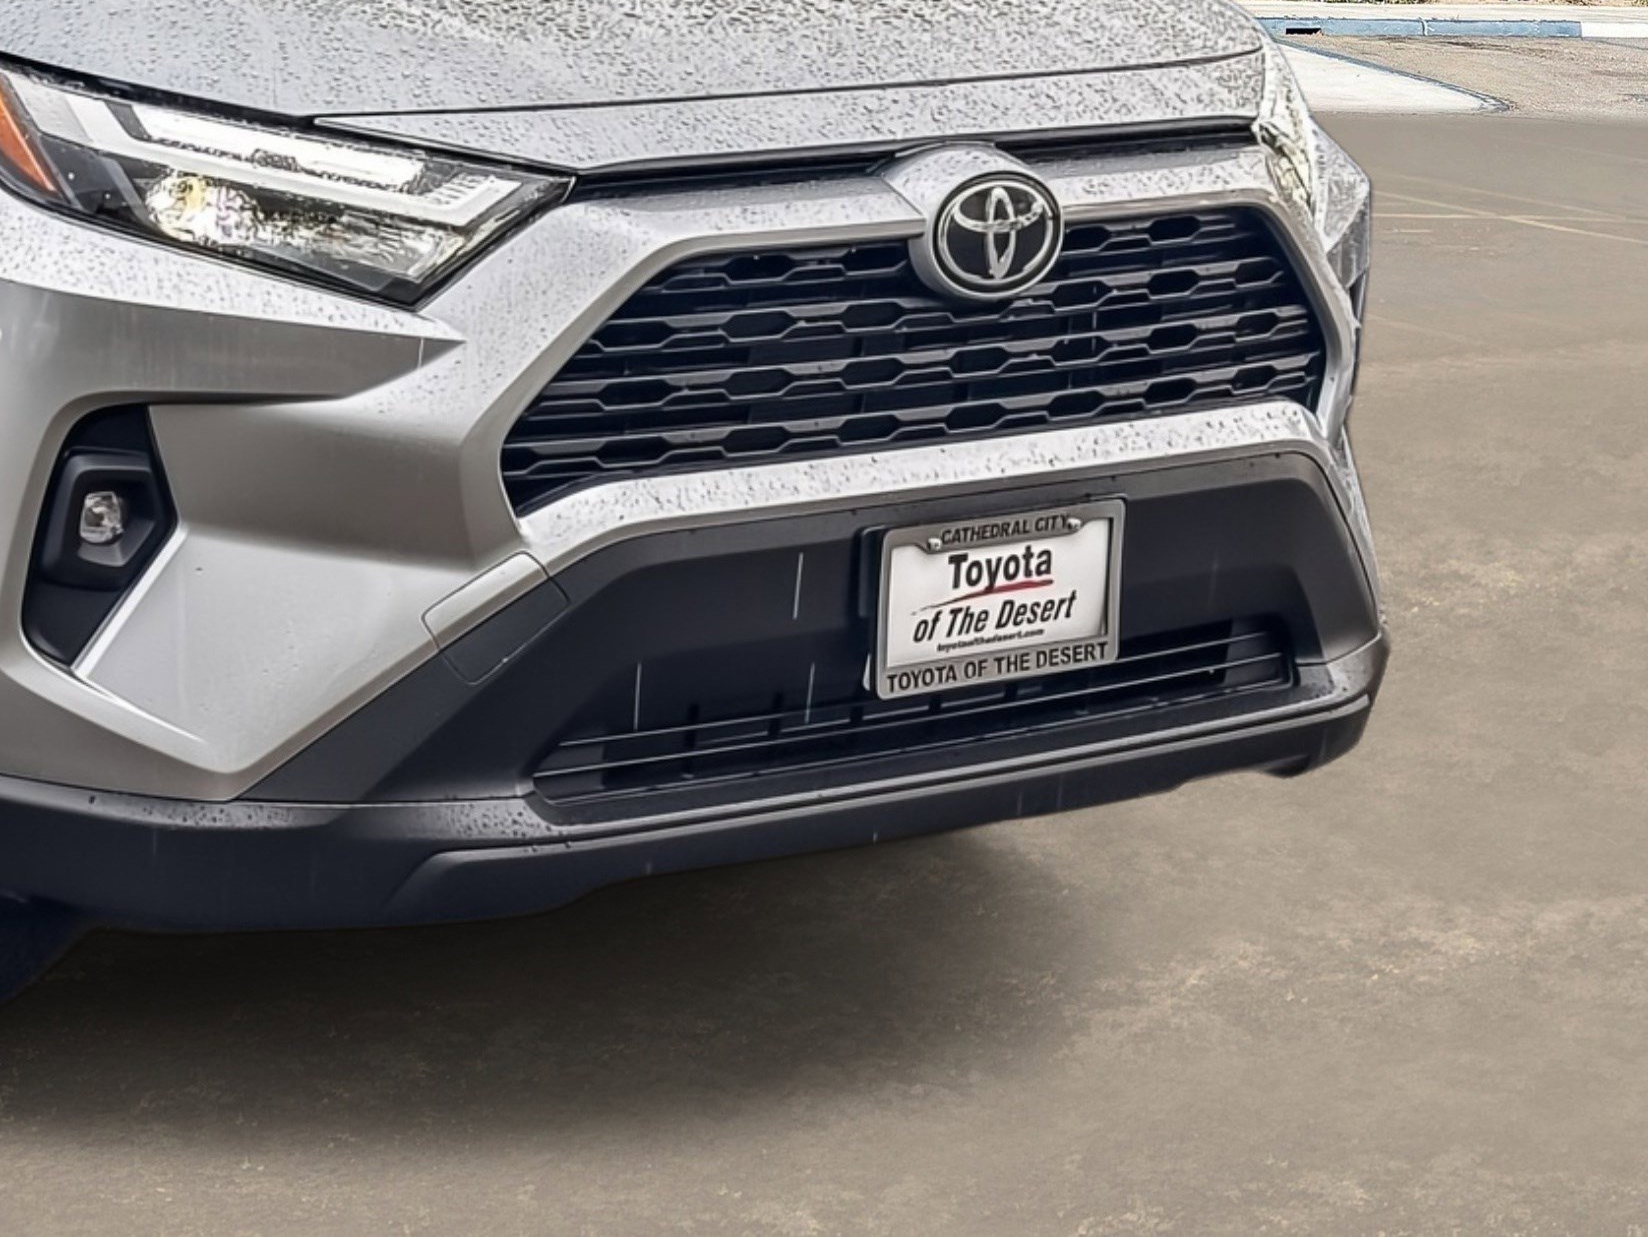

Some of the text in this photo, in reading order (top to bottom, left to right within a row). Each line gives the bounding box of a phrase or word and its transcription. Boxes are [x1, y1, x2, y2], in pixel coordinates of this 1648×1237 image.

[941, 513, 1073, 545] CATHEDRAL CITY
[948, 545, 1053, 593] Toyota
[913, 590, 1077, 643] of The Desert
[887, 641, 1108, 693] TOYOTA OF THE DESERT
